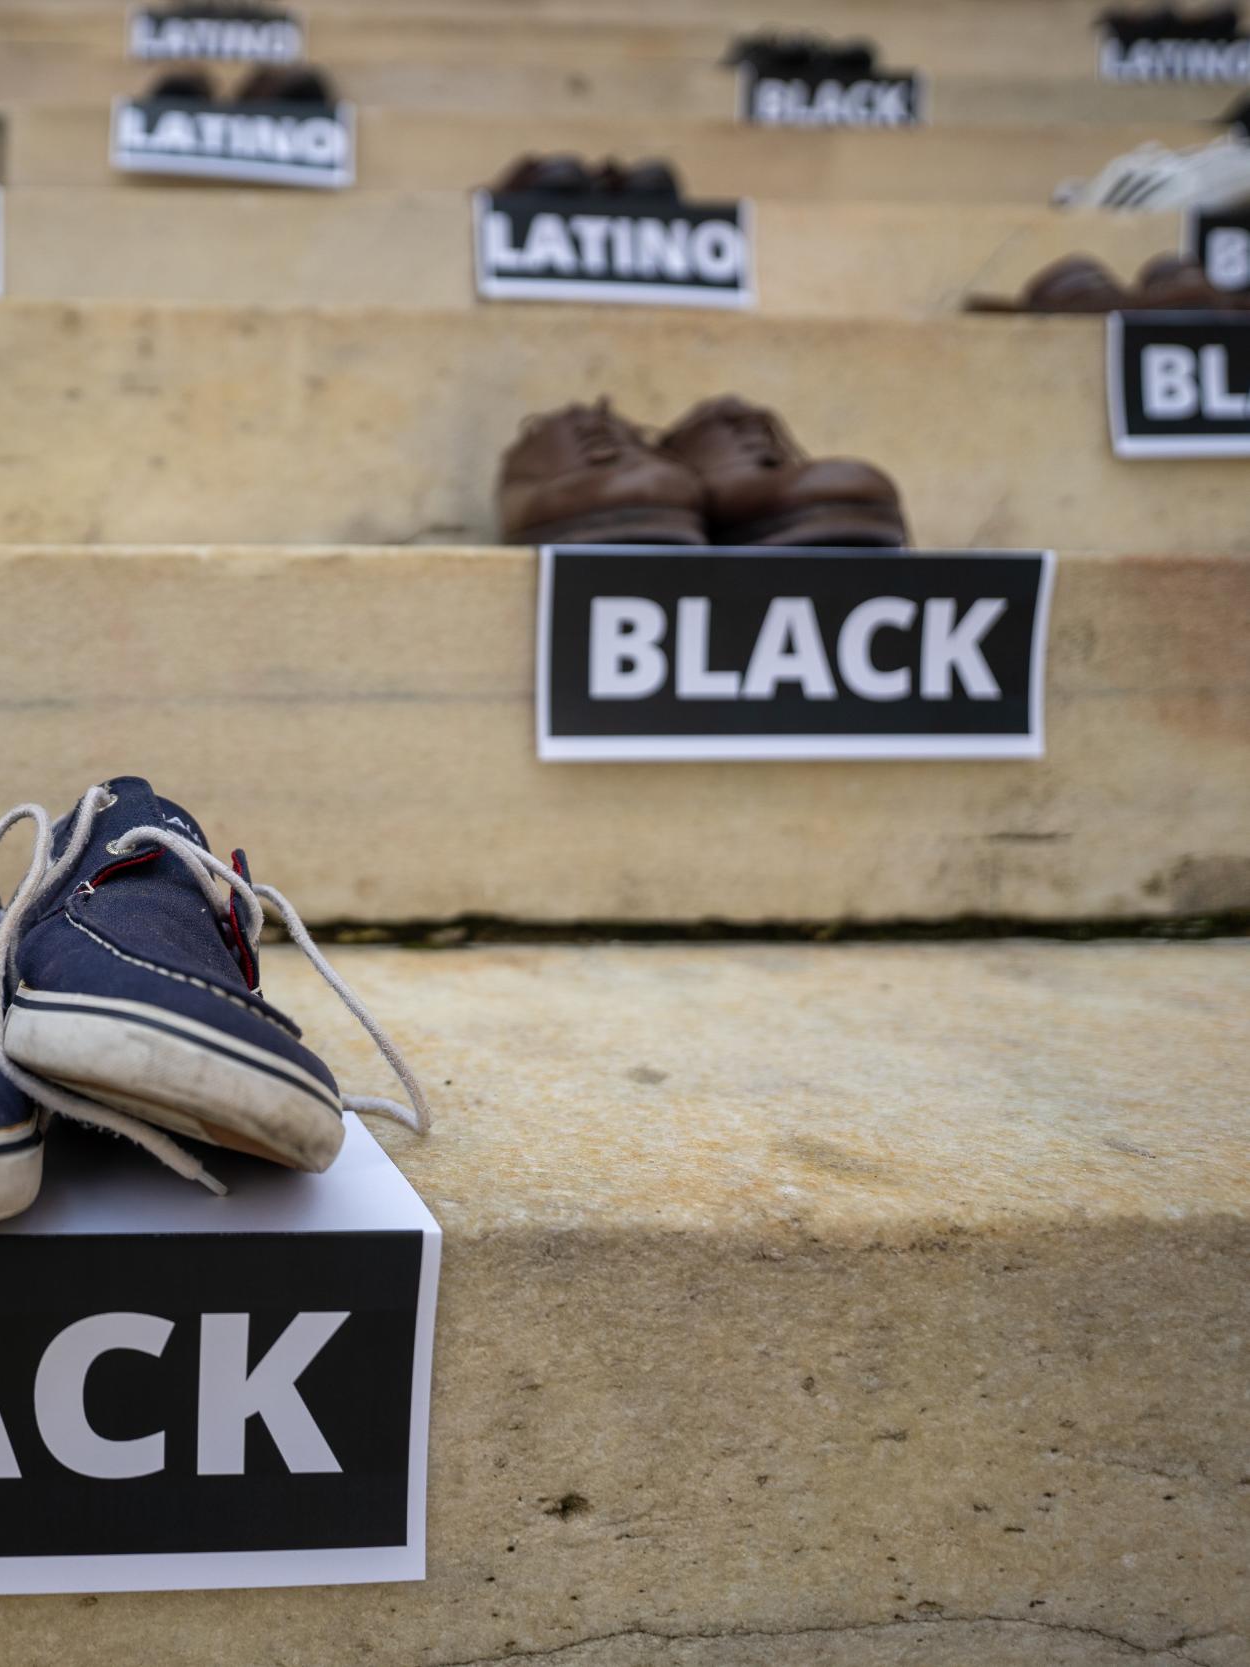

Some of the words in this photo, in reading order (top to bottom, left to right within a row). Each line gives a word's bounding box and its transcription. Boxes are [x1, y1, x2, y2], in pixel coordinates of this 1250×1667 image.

[131, 15, 302, 62] LATINO
[754, 78, 910, 126] BLACK
[118, 107, 348, 166] LATINO
[483, 209, 745, 283] LATINO
[1140, 344, 1250, 420] BL
[588, 596, 1005, 701] BLACK
